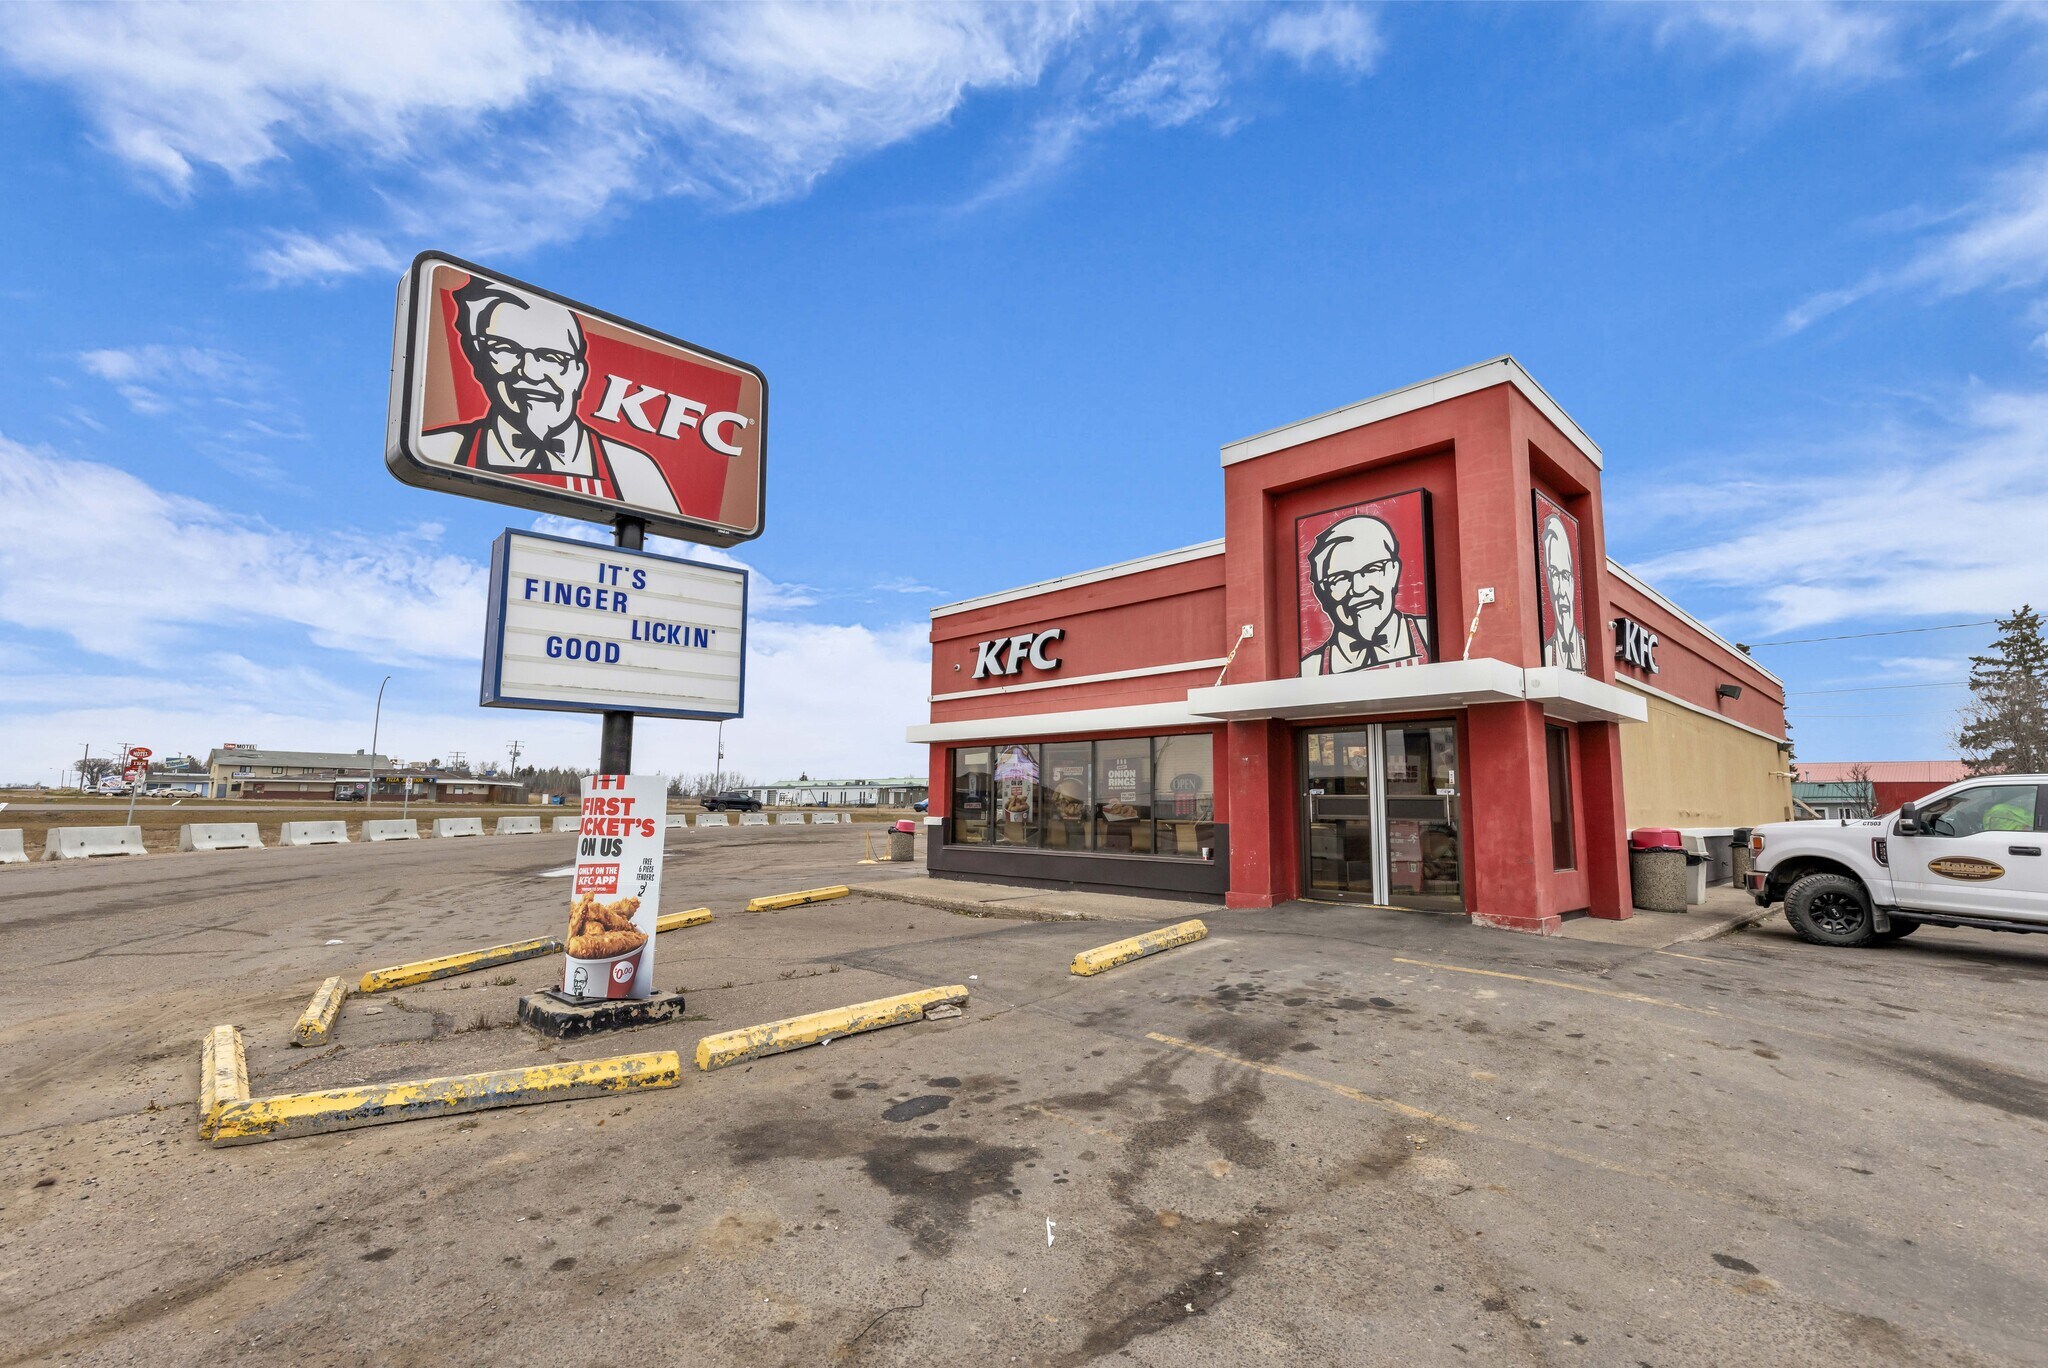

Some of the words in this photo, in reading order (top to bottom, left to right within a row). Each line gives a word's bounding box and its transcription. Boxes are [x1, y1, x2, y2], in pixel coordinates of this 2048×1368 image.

[591, 374, 748, 456] KFC
[599, 563, 646, 590] IT'S
[525, 578, 628, 613] FINGER
[632, 620, 715, 648] LICKIN'
[546, 636, 620, 664] GOOD
[972, 628, 1063, 678] KFC
[1624, 618, 1659, 674] KFC
[1108, 769, 1136, 778] ONION
[1108, 778, 1136, 787] RINGS
[1173, 780, 1196, 789] OPEN
[581, 797, 636, 816] FIRST
[581, 838, 597, 856] ON
[600, 838, 623, 857] US
[579, 867, 595, 875] ONLY
[595, 867, 605, 875] ON
[642, 858, 653, 866] FREE
[578, 876, 594, 886] KFC
[595, 876, 616, 885] APP
[636, 873, 655, 881] TENDERS
